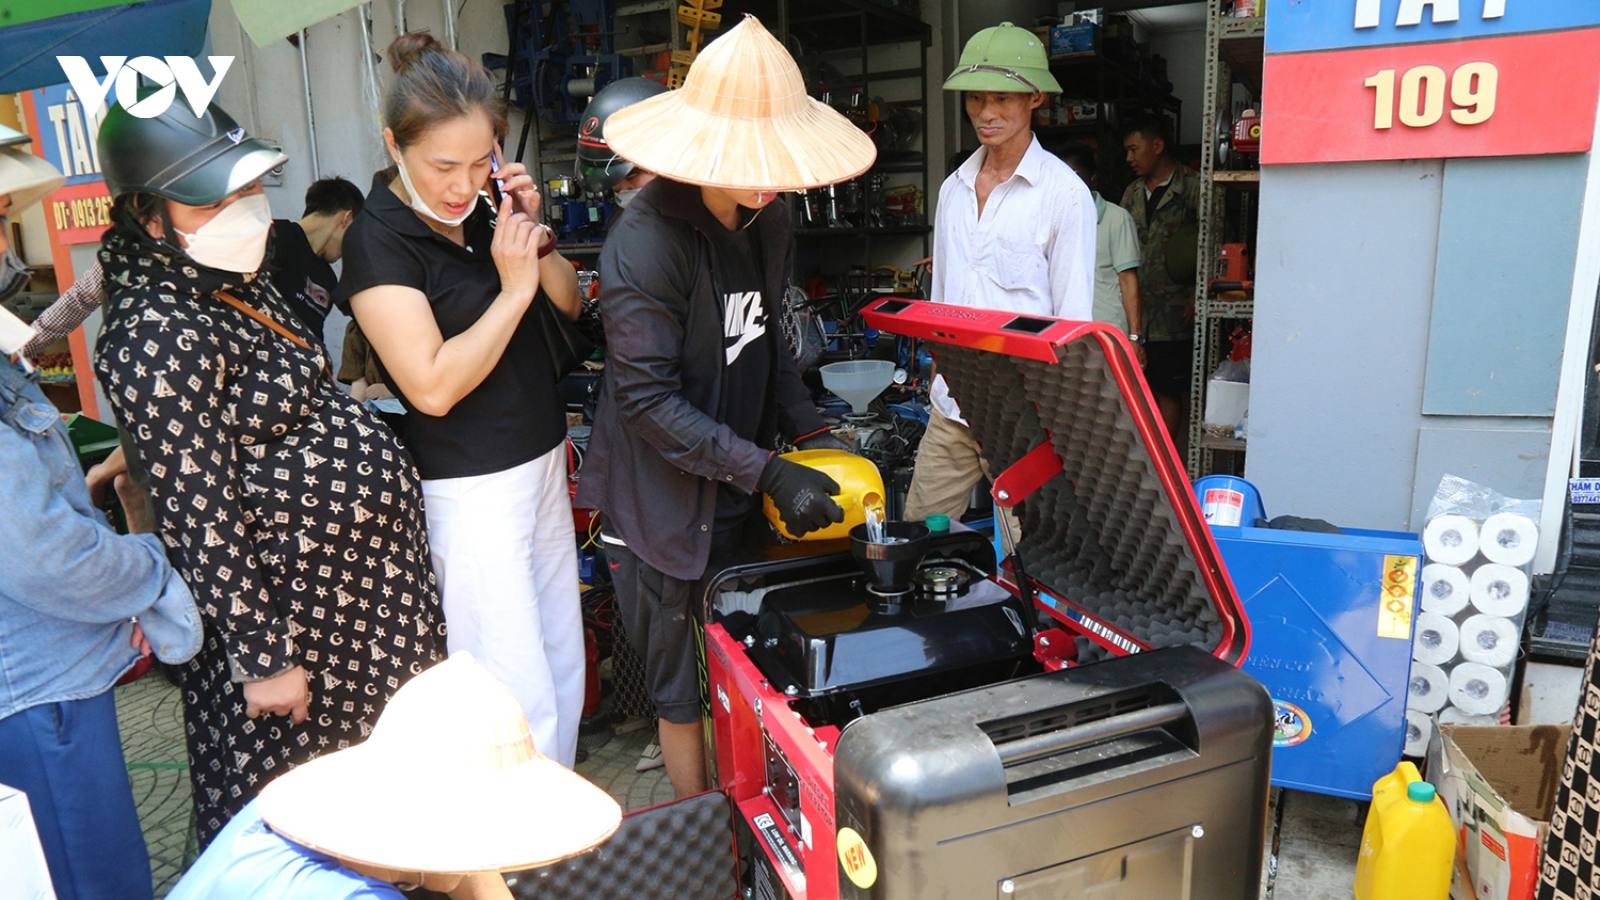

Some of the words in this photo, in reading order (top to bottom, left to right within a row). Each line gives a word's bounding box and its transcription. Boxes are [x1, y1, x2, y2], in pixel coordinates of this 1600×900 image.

[1364, 61, 1499, 130] 109
[71, 197, 96, 228] 0913
[845, 842, 866, 875] NEW
